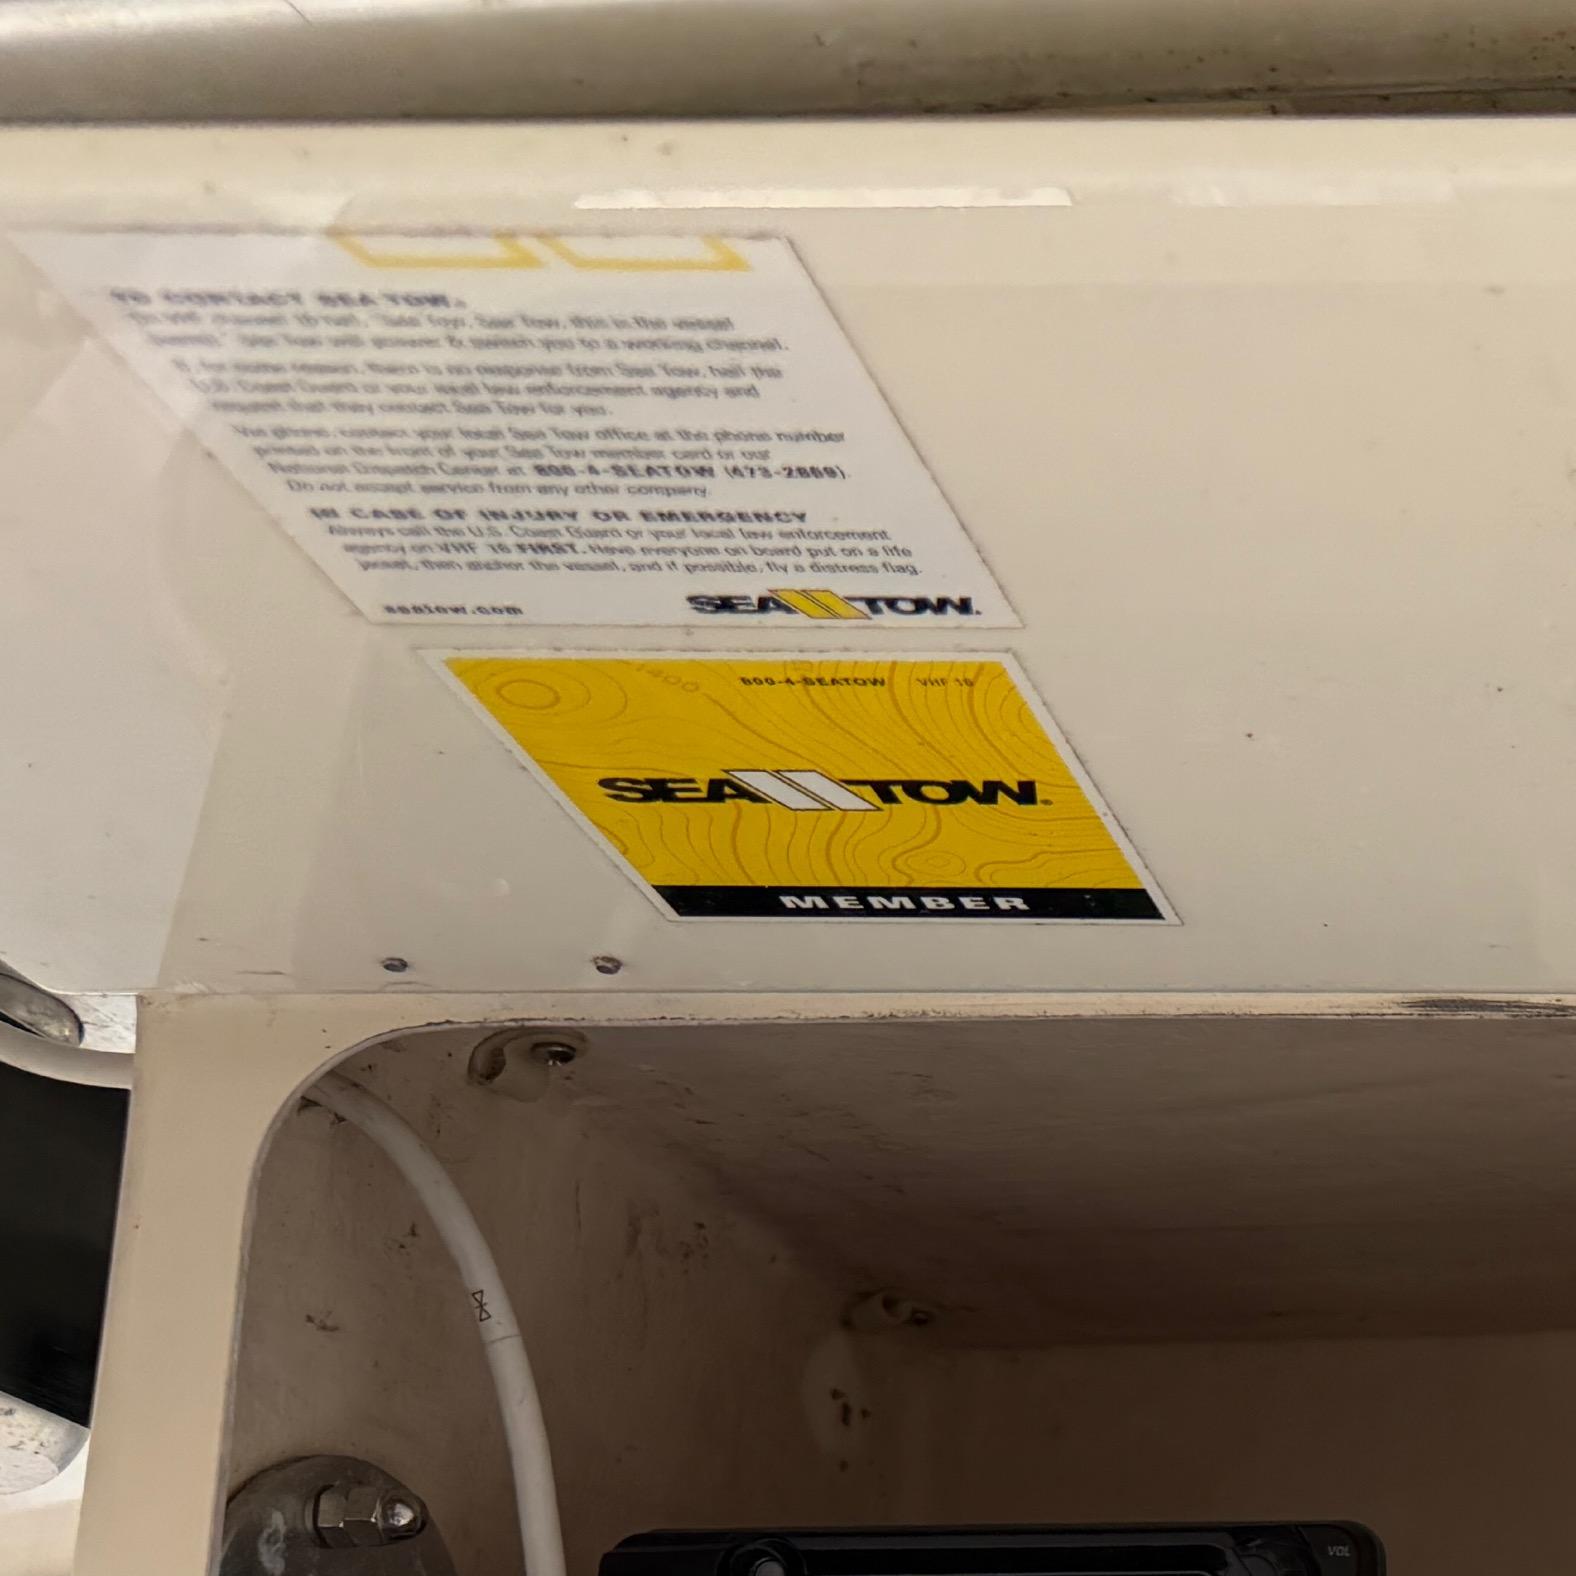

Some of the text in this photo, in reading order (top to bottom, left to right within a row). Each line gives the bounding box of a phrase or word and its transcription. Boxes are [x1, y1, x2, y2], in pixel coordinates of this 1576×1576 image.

[160, 291, 302, 306] CONTACT
[316, 292, 377, 307] SEA
[633, 315, 667, 331] the
[750, 363, 782, 379] the
[650, 383, 720, 399] agency
[724, 383, 761, 400] and
[458, 427, 505, 443] local
[508, 427, 546, 444] Sea
[593, 427, 652, 445] office
[653, 427, 673, 445] at
[675, 427, 708, 445] the
[713, 427, 773, 446] phone
[775, 427, 846, 447] number
[351, 445, 384, 460] the
[589, 445, 666, 461] member
[671, 445, 714, 461] card
[740, 445, 771, 461] our
[319, 479, 348, 495] not
[418, 480, 485, 496] service
[487, 481, 533, 496] from
[536, 481, 569, 497] any
[574, 482, 621, 497] other
[308, 506, 808, 523] IN CASE OF INJURY OR EMERGENCY
[396, 526, 431, 540] call
[434, 526, 467, 540] the
[508, 526, 564, 541] Coast
[564, 527, 623, 542] Guard
[626, 527, 644, 542] or
[649, 527, 687, 542] your
[692, 528, 736, 543] local
[740, 528, 774, 543] law
[778, 529, 892, 544] enforcement
[410, 544, 435, 558] on
[436, 544, 480, 558] VHF
[487, 544, 513, 559] 16
[514, 544, 588, 559] FIRST.
[588, 544, 636, 560] Have
[639, 545, 721, 560] everyone
[724, 545, 748, 561] on
[750, 545, 803, 561] board
[807, 545, 836, 562] put
[839, 545, 864, 562] on
[881, 546, 913, 562] life
[421, 559, 465, 574] then
[465, 560, 525, 575] anchor
[528, 560, 561, 575] the
[562, 560, 626, 575] vessel,
[629, 560, 662, 575] and
[664, 560, 678, 576] if
[684, 560, 764, 576] possible,
[765, 560, 790, 576] fly
[809, 560, 879, 577] distress
[881, 560, 923, 577] flag.
[383, 603, 524, 616] seatow.com
[686, 595, 799, 615] SEA
[740, 677, 886, 687] 800-4-SEATOW
[597, 777, 773, 804] SEA
[779, 894, 1031, 912] MEMBER
[1326, 1545, 1351, 1557] VOL
